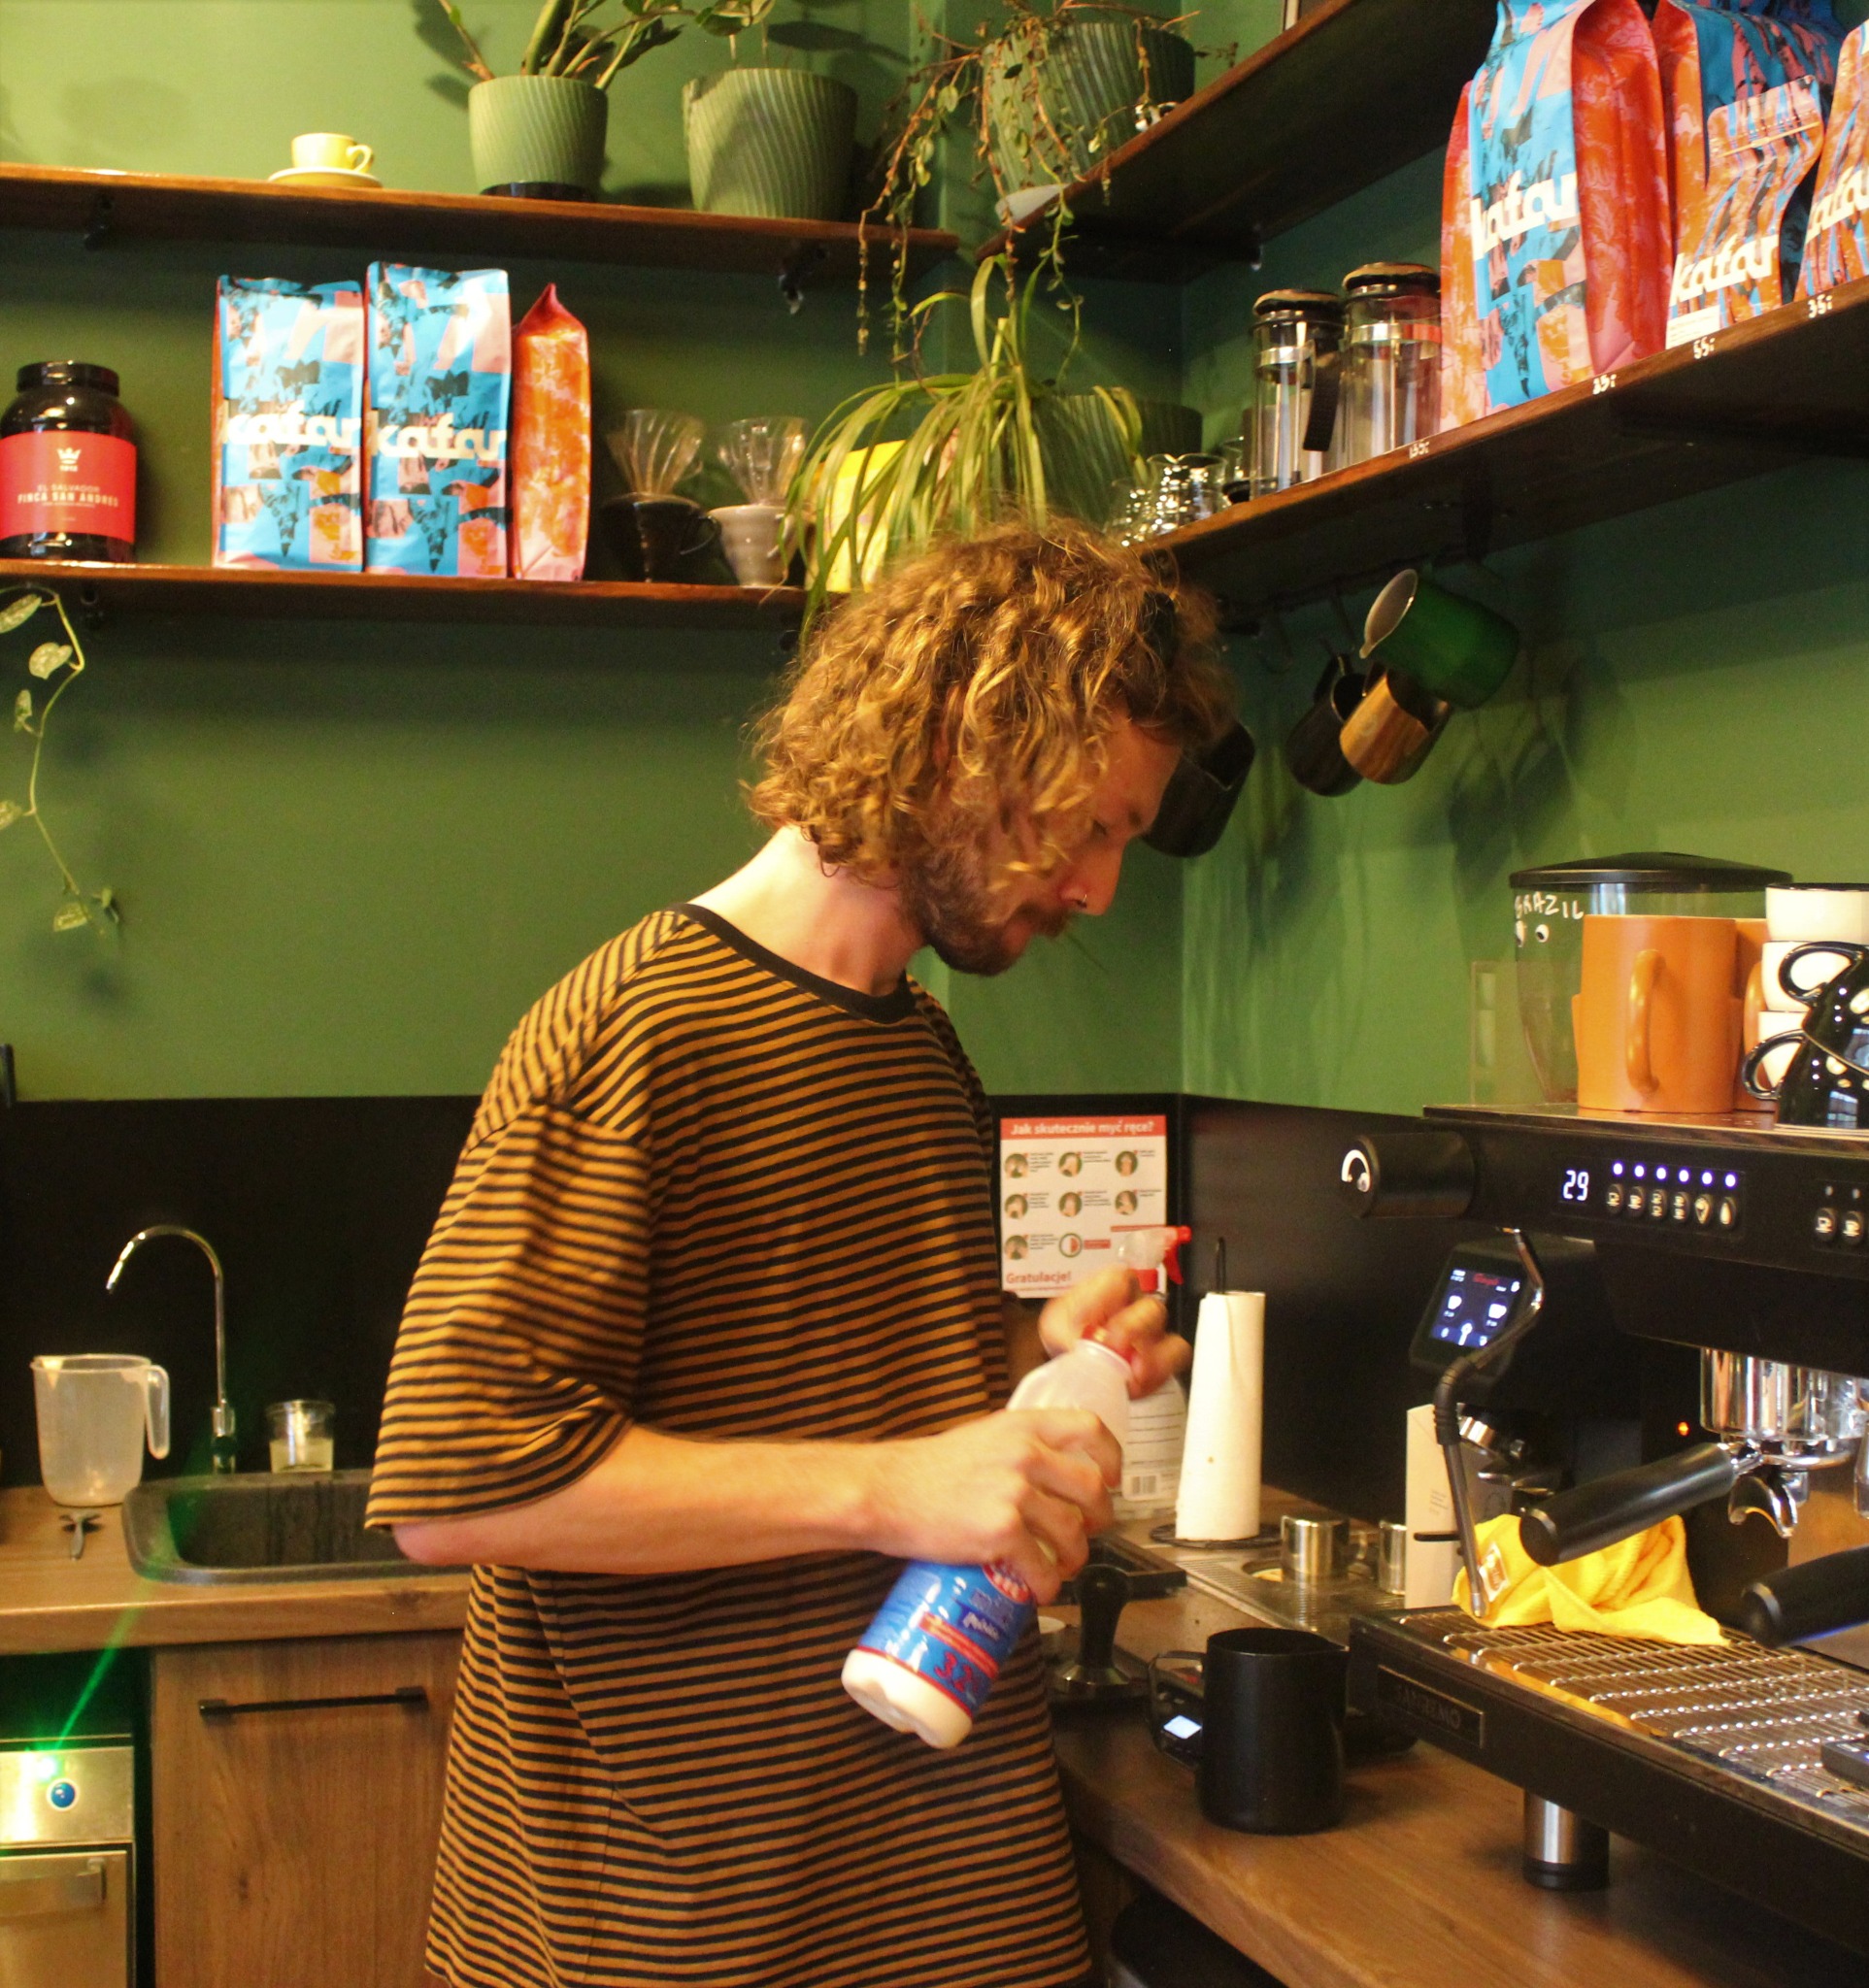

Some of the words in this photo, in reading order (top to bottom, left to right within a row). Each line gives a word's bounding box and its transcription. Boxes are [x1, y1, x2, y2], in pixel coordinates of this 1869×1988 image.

[1669, 233, 1780, 308] kafar
[223, 398, 361, 447] kafar
[370, 412, 507, 459] kafar
[17, 491, 48, 504] FINCA
[51, 491, 75, 503] SAN
[51, 483, 100, 493] SALVADOR
[1515, 890, 1585, 919] BRAZIL
[1011, 1122, 1032, 1136] Jak
[1034, 1121, 1096, 1135] skutecznie
[1098, 1119, 1121, 1136] myć
[1123, 1120, 1155, 1136] ręce?
[1562, 1169, 1589, 1202] 29
[1006, 1271, 1072, 1285] Gratulacje!
